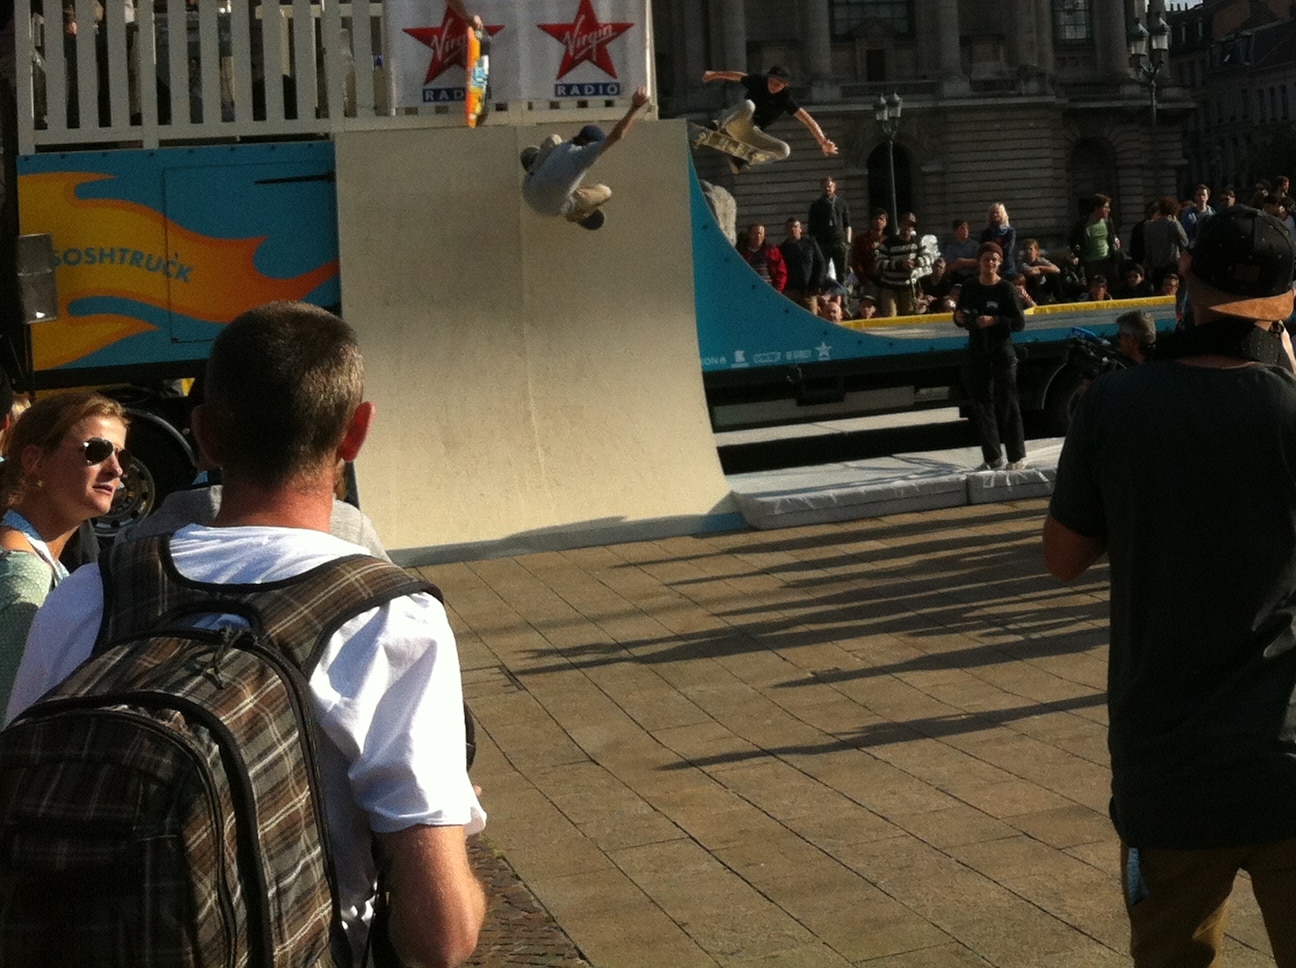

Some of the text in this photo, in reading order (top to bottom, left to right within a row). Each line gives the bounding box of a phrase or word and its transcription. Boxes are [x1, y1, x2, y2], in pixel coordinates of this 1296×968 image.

[562, 14, 613, 62] Virgin
[424, 88, 466, 102] RAD
[557, 83, 619, 98] RADIO
